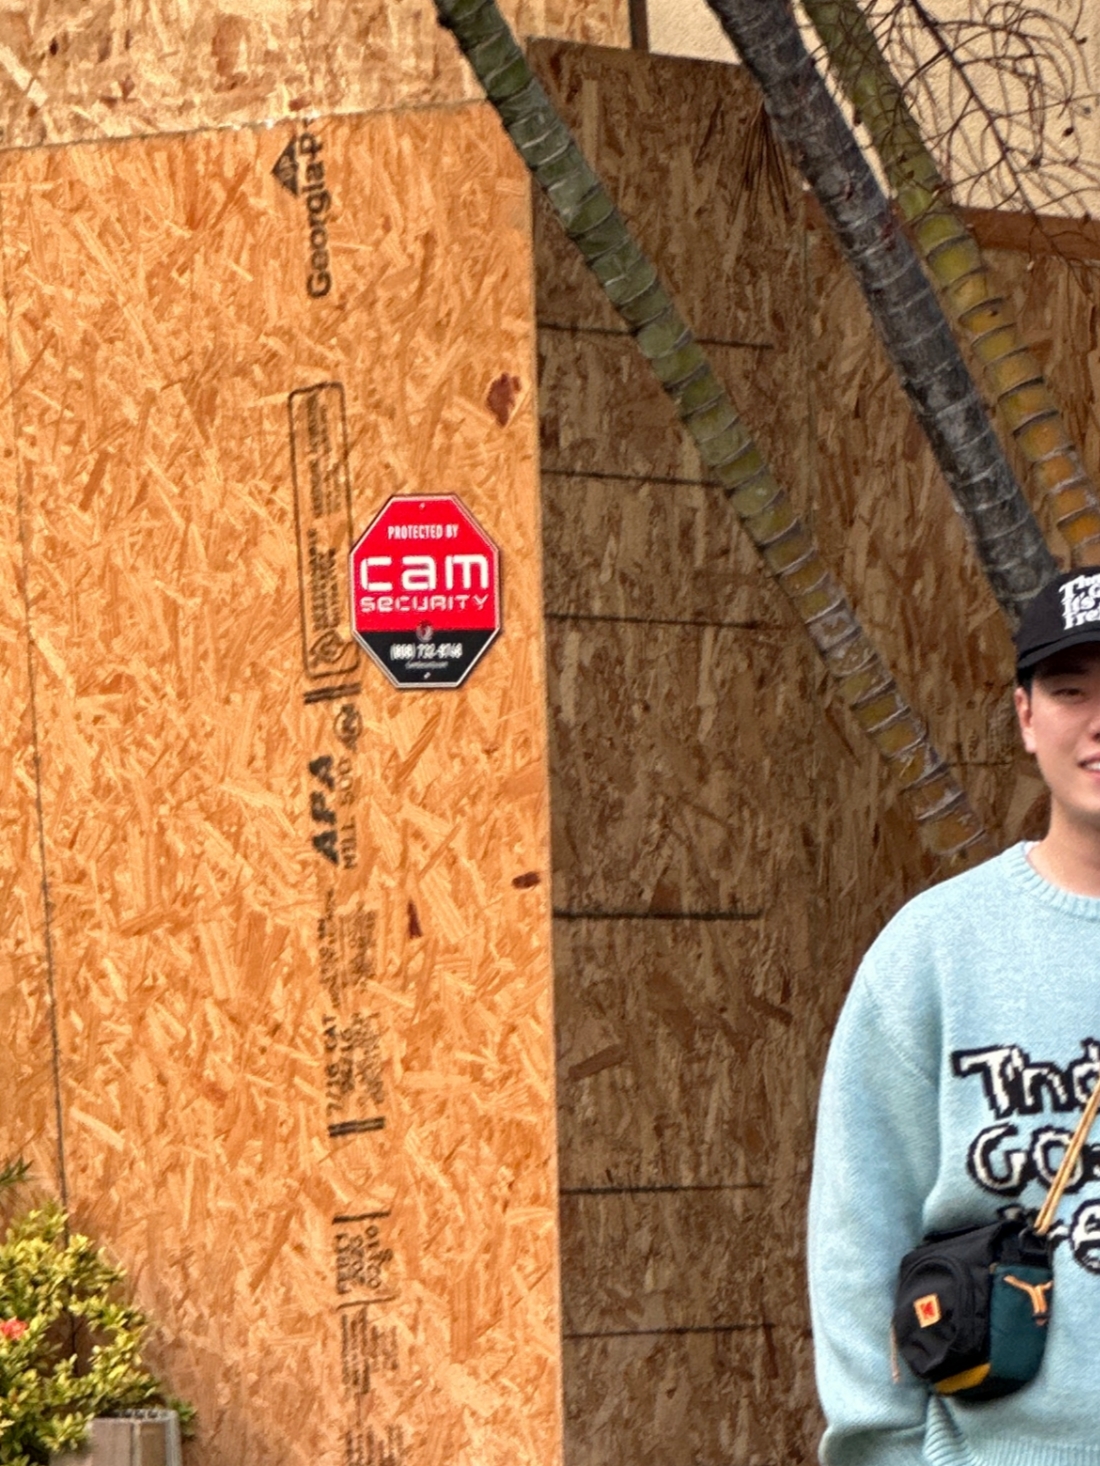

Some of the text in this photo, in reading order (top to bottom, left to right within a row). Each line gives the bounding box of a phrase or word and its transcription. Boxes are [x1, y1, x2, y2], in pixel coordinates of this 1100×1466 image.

[387, 524, 460, 540] PROTECTED BY
[359, 554, 490, 592] cam
[307, 754, 339, 865] APA
